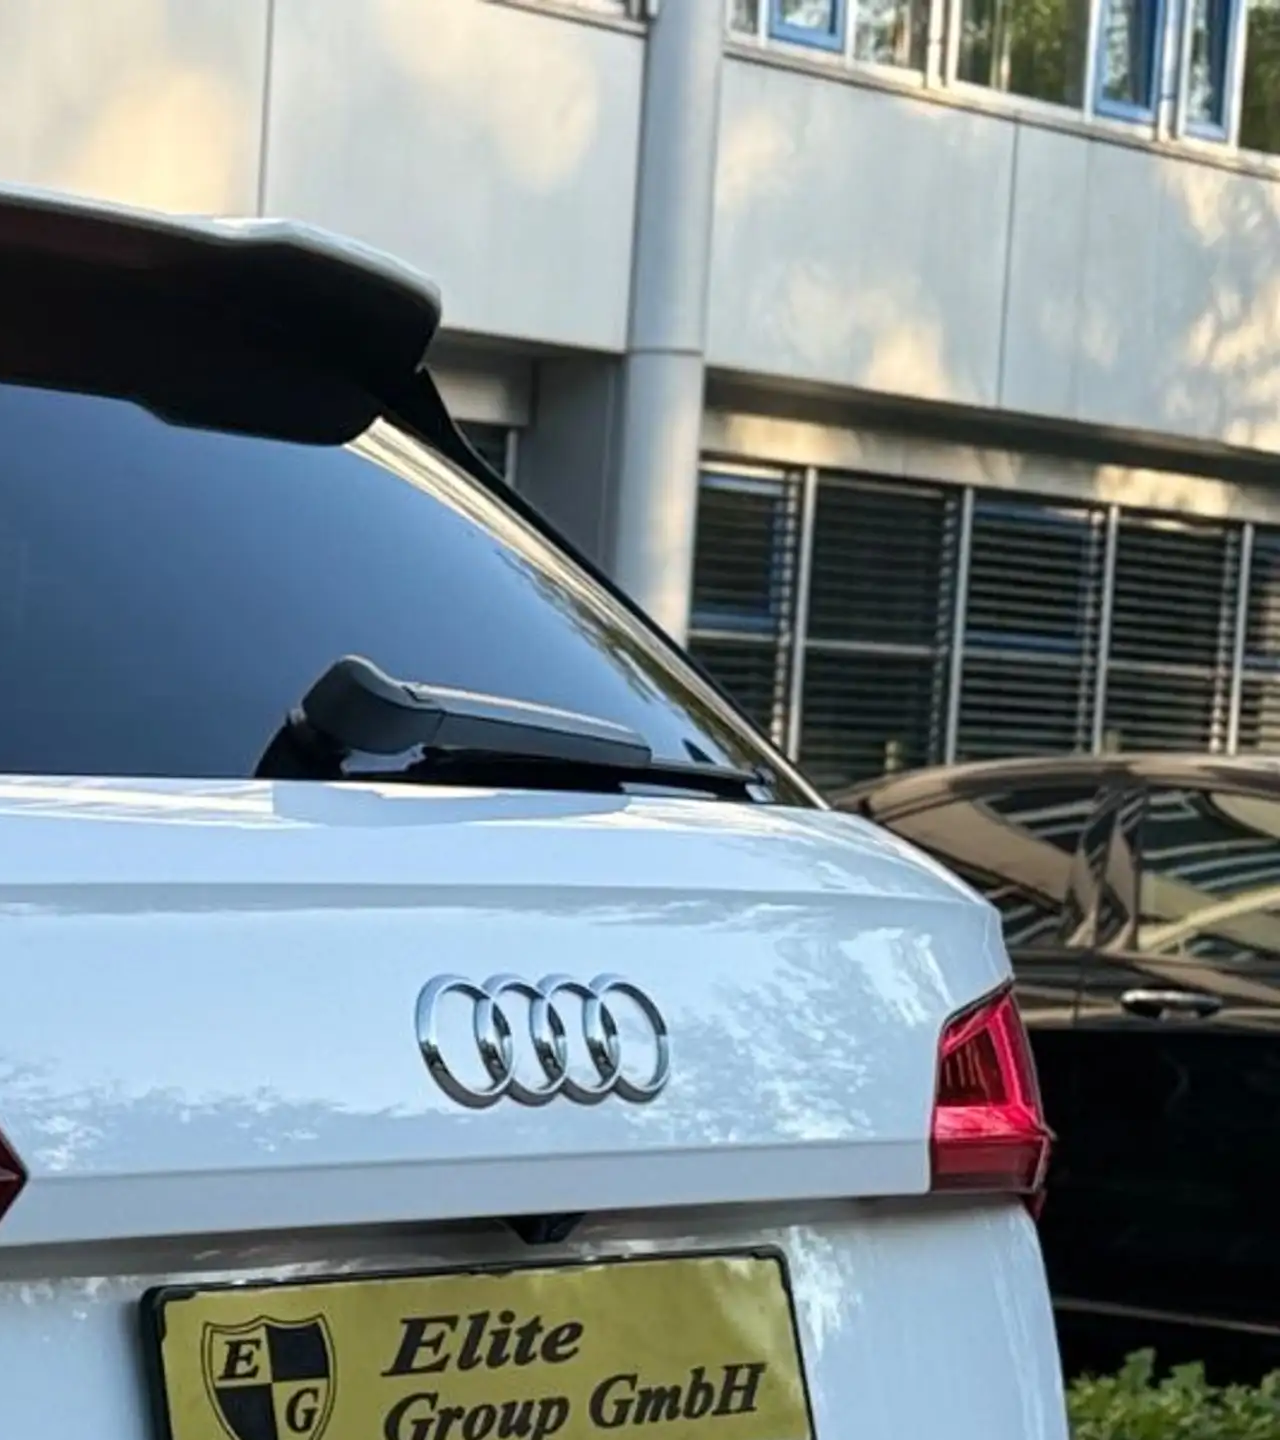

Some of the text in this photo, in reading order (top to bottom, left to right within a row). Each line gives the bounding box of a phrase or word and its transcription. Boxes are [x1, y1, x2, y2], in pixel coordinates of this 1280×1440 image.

[218, 1338, 261, 1380] E
[381, 1309, 585, 1377] Elite
[286, 1389, 320, 1434] G
[588, 1361, 766, 1429] GmbH
